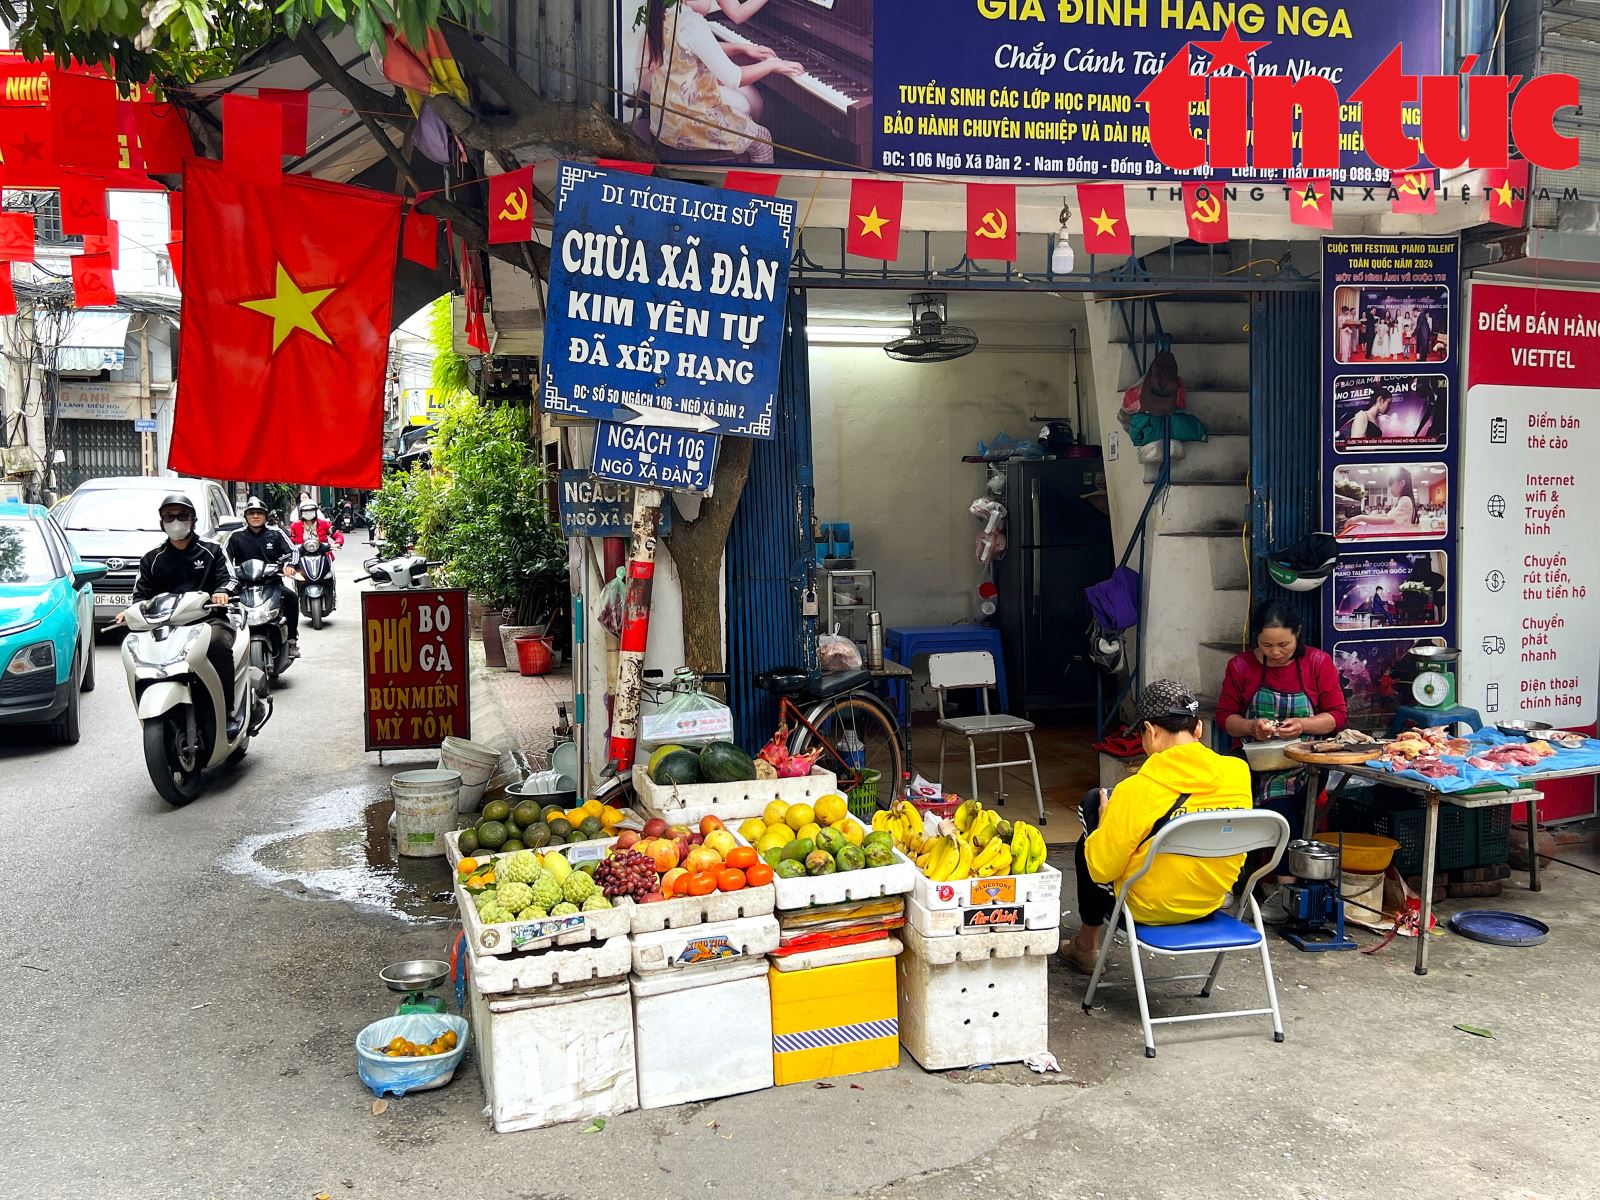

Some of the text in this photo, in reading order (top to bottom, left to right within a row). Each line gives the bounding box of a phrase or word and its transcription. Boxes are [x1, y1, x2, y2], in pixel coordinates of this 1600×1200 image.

[977, 0, 1046, 22] GIA
[1277, 4, 1353, 39] NGA
[994, 42, 1057, 76] Chắp
[1063, 47, 1126, 75] Cánh
[6, 71, 50, 106] NHIỆ
[898, 79, 946, 105] TUYỂN
[950, 87, 985, 107] SINH
[989, 86, 1019, 109] CÁC
[1023, 88, 1051, 109] LỚP
[1054, 92, 1083, 115] HỌC
[1087, 93, 1131, 113] PIANO
[883, 110, 1151, 147] BẢO HÀNH CHUYÊN NGHIỆP VÀ DÀI HẠ
[882, 150, 905, 167] ĐC:
[908, 152, 933, 168] 106
[936, 152, 962, 171] Ngõ
[965, 153, 982, 169] Xã
[985, 154, 1011, 171] Đàn
[1013, 155, 1022, 171] 2
[1034, 156, 1063, 172] Nam
[1110, 156, 1143, 175] Đống
[1145, 159, 1162, 175] Đa
[601, 184, 759, 227] DI TÍCH LỊCH SỬ
[1327, 242, 1455, 255] CUỘC THI FESTIVAL PIANO TALENT
[562, 224, 779, 302] CHÙA XÃ ĐÀN
[1348, 256, 1433, 270] TOÀN QUỐC NĂM 2024
[567, 290, 765, 350] KIM YÊN TỰ
[1478, 304, 1600, 338] ĐIỂM BÁN HÀN
[568, 333, 754, 386] ĐÃ XẾP HẠNG
[1510, 347, 1576, 369] VIETTEL
[592, 383, 607, 402] SỐ
[607, 389, 620, 403] 50
[622, 389, 654, 407] NGÁCH
[655, 395, 673, 410] 106
[680, 397, 701, 413] NGÕ
[702, 399, 716, 416] XÃ
[717, 401, 737, 418] ĐÀN
[738, 405, 745, 419] 2
[1528, 411, 1580, 429] Điểm bán
[607, 424, 706, 461] NGÁCH 106
[1527, 434, 1568, 449] thẻ cào
[600, 457, 704, 486] NGÕ XÃ ĐÀN 2
[1526, 473, 1575, 486] Internet
[1525, 490, 1560, 502] wifi &
[566, 507, 597, 526] NGÕ
[600, 508, 621, 526] XÃ
[1525, 504, 1566, 521] Truyền
[1524, 522, 1551, 535] hình
[1523, 551, 1567, 571] Chuyển
[1523, 568, 1571, 584] rút tiền,
[1522, 585, 1586, 601] thu tiền hộ
[418, 595, 451, 633] BÒ
[1522, 612, 1565, 632] Chuyển
[368, 597, 413, 675] PHỞ
[1521, 633, 1548, 649] phát
[419, 635, 453, 672] GÀ
[1521, 648, 1557, 662] nhanh
[1520, 675, 1579, 693] Điện thoại
[1520, 693, 1582, 710] chính hãng
[411, 710, 454, 740] TÔM
[969, 909, 1019, 926] Air Chief
